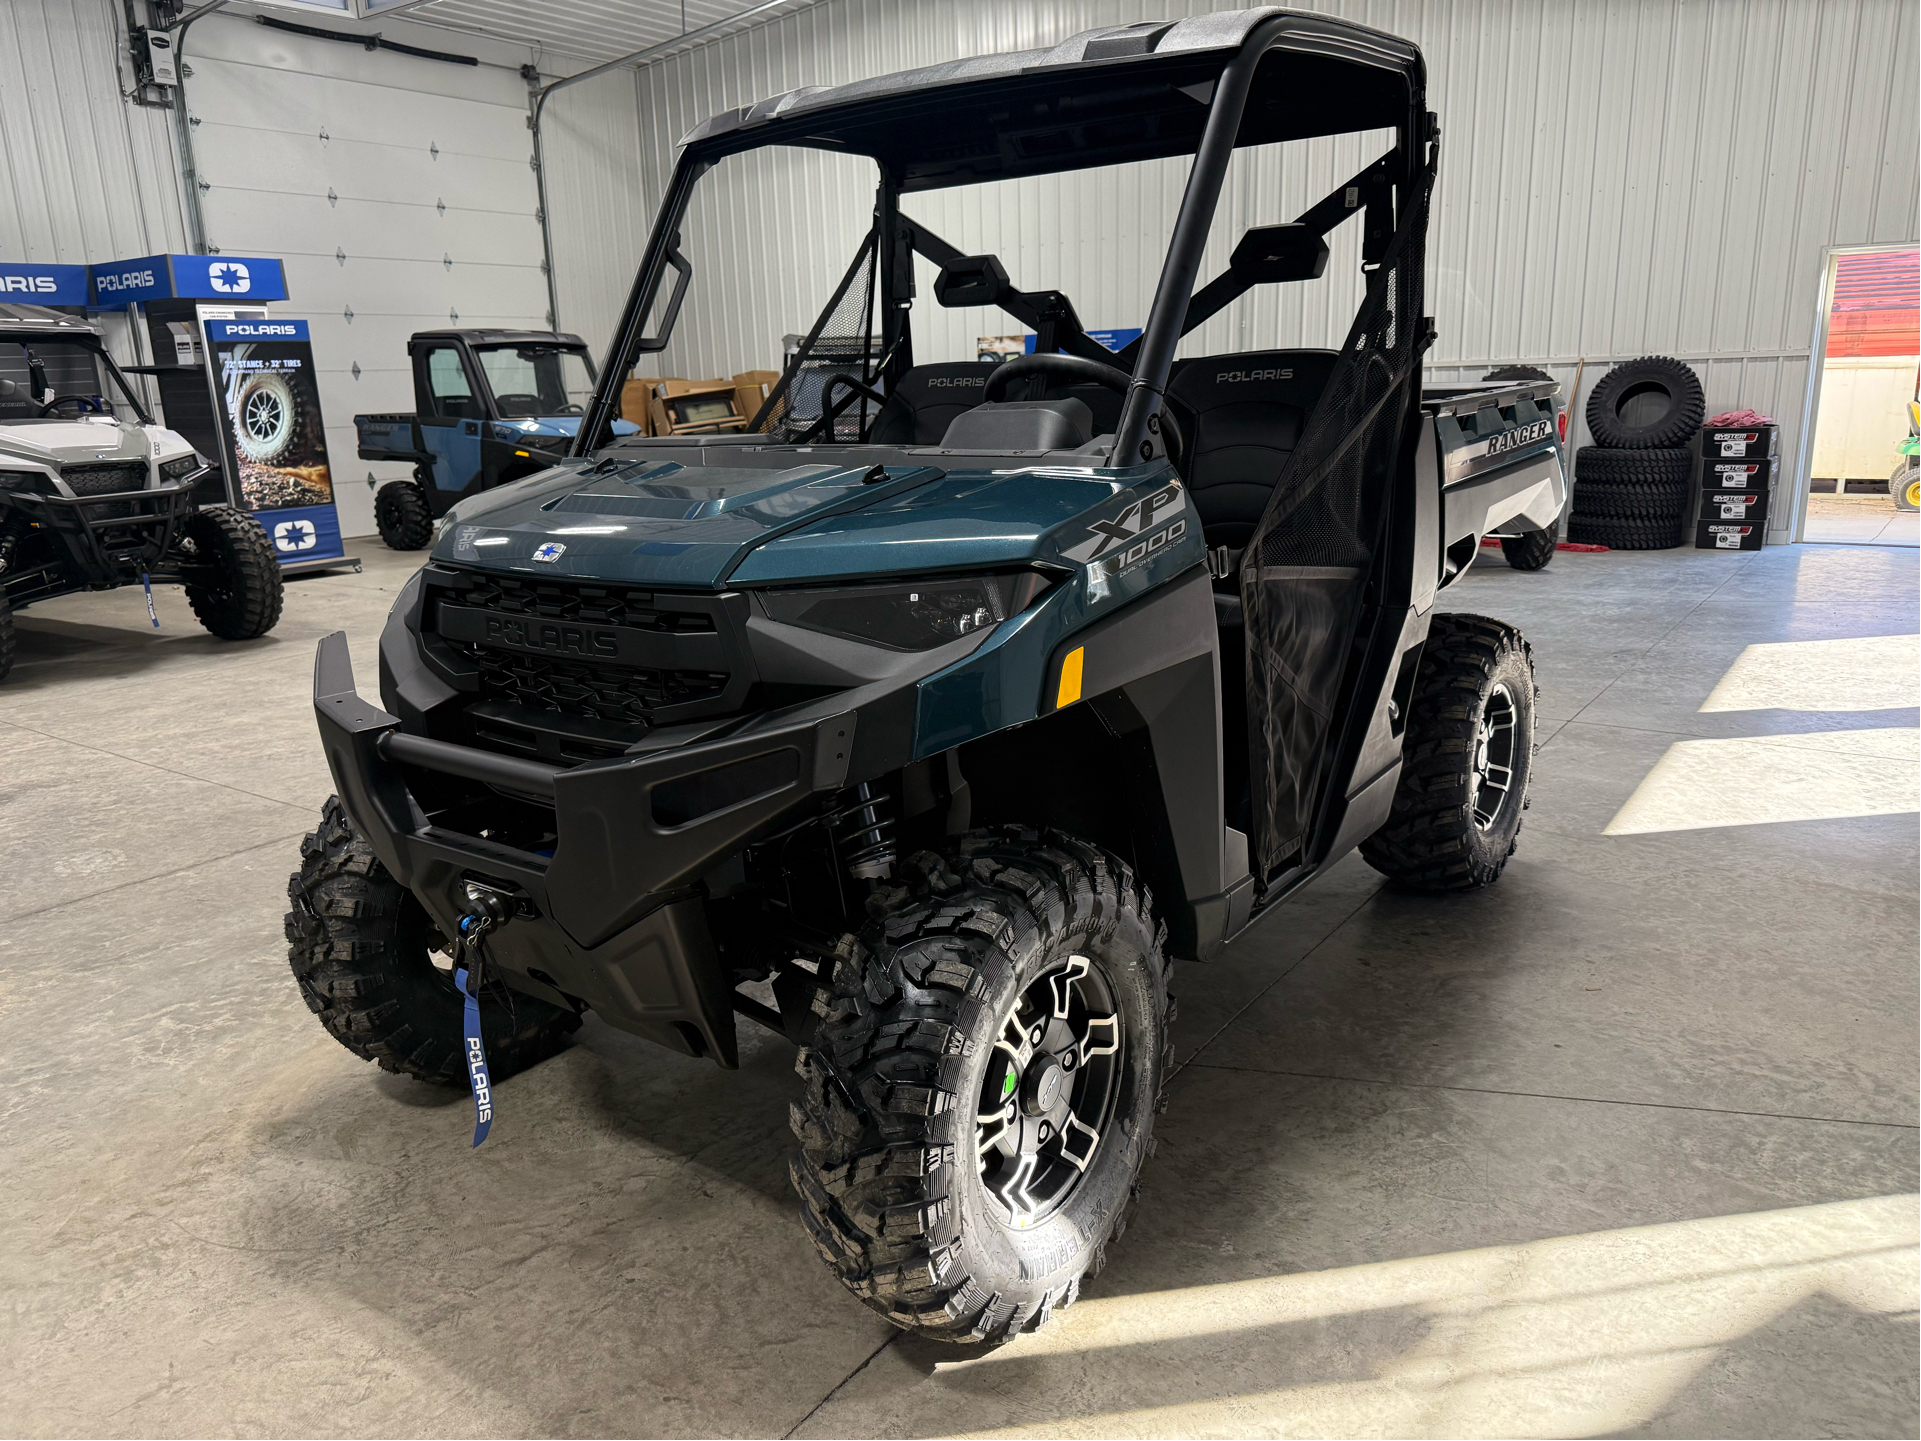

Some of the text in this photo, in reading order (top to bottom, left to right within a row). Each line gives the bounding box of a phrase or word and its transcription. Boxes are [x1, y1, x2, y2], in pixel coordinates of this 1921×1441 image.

[96, 270, 155, 293] POLARIS
[225, 325, 297, 335] POLARIS
[237, 360, 264, 368] STANCE
[282, 359, 302, 367] TIRES
[1215, 367, 1294, 384] POLARIS
[928, 376, 985, 388] POLARIS
[1485, 419, 1549, 458] RANGER
[1086, 484, 1182, 561] XP
[1117, 518, 1186, 570] 1000
[1119, 564, 1138, 578] DUAL
[1138, 545, 1172, 567] OVERHEAD
[484, 615, 619, 659] POLARIS
[466, 1037, 492, 1124] POLARIS
